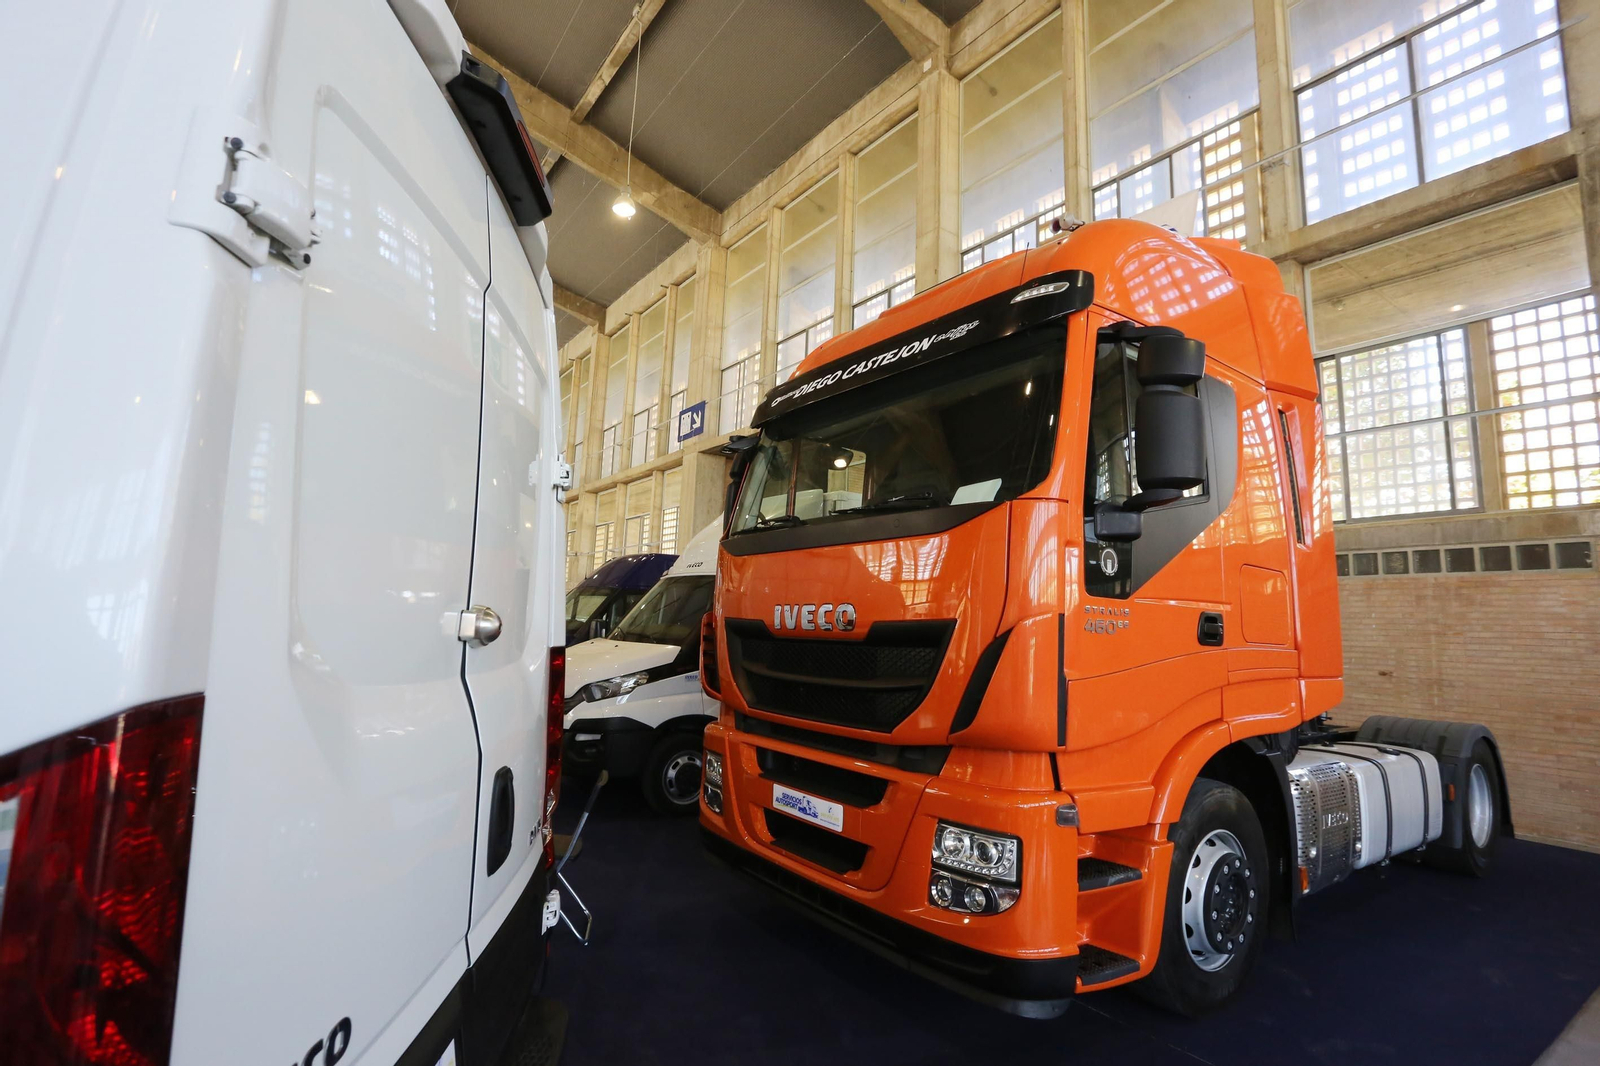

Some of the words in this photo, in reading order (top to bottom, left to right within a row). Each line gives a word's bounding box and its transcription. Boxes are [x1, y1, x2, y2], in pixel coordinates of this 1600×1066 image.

[793, 370, 843, 399] DIEGO
[842, 334, 937, 380] CASTEJON
[774, 603, 857, 631] IVECO
[1084, 605, 1130, 617] STRALIS
